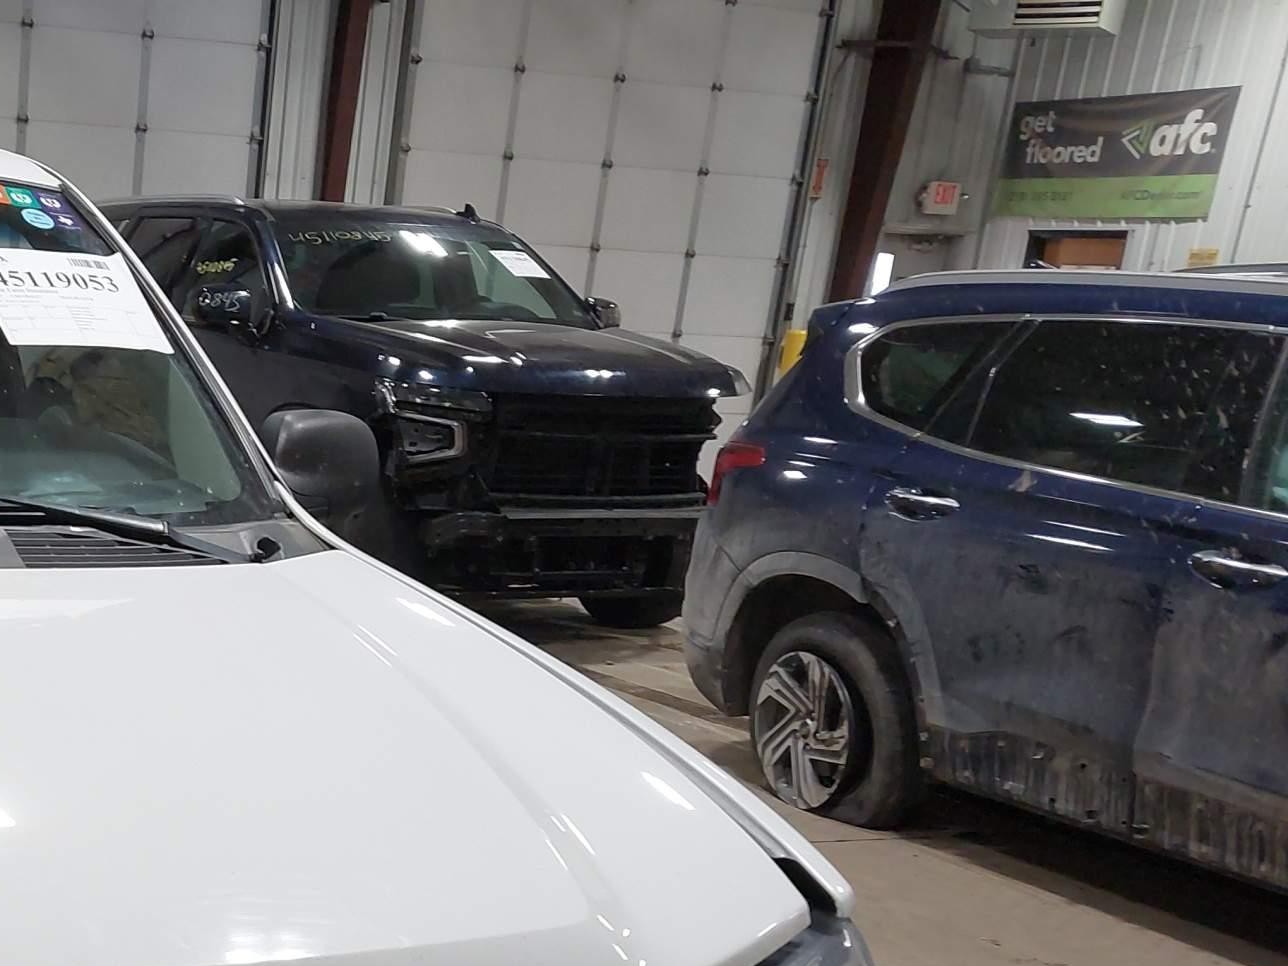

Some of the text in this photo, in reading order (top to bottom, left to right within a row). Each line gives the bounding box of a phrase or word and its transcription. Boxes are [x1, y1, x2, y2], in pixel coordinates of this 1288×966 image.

[1019, 111, 1057, 141] get
[1149, 108, 1217, 157] afc
[1025, 136, 1104, 164] floored
[934, 184, 957, 204] EXIT
